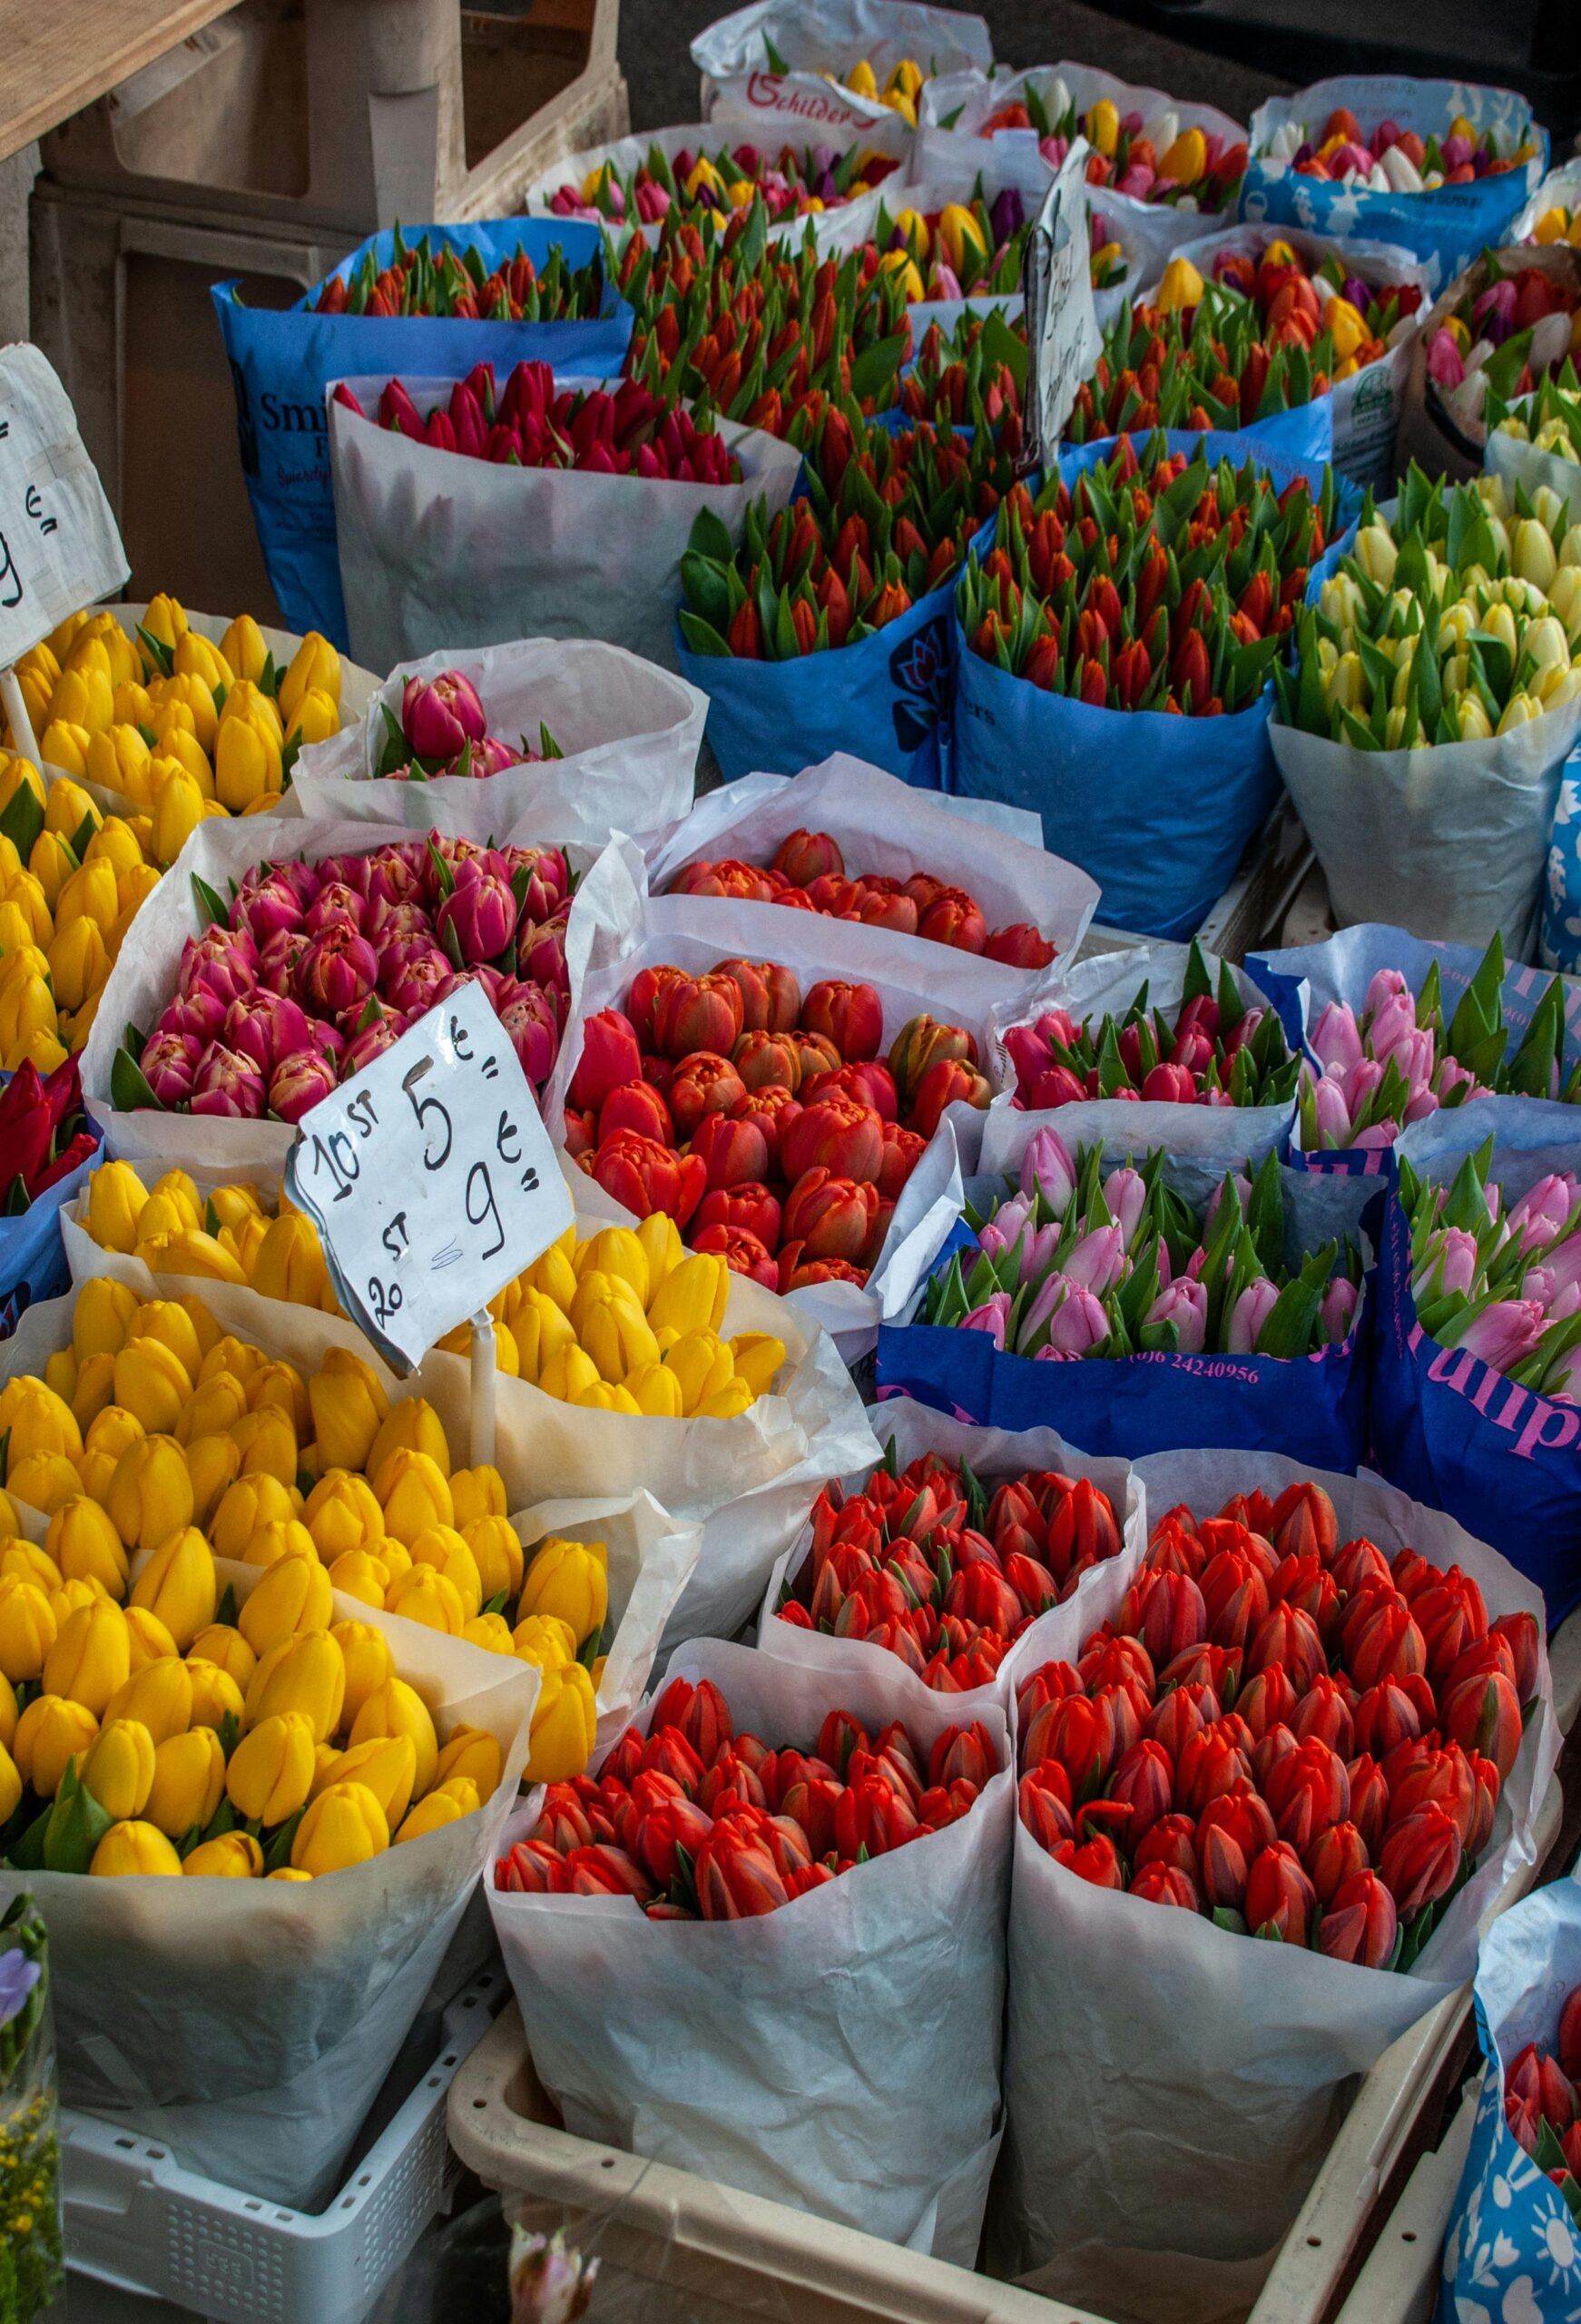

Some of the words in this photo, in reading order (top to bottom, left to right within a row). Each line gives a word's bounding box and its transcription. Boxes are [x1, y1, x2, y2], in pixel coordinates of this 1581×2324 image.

[747, 71, 853, 125] Schilder
[260, 392, 328, 431] Smi
[312, 1130, 360, 1202] 10
[402, 1055, 452, 1171] 5
[1171, 1353, 1260, 1384] 24240956
[1408, 1321, 1581, 1461] ulip
